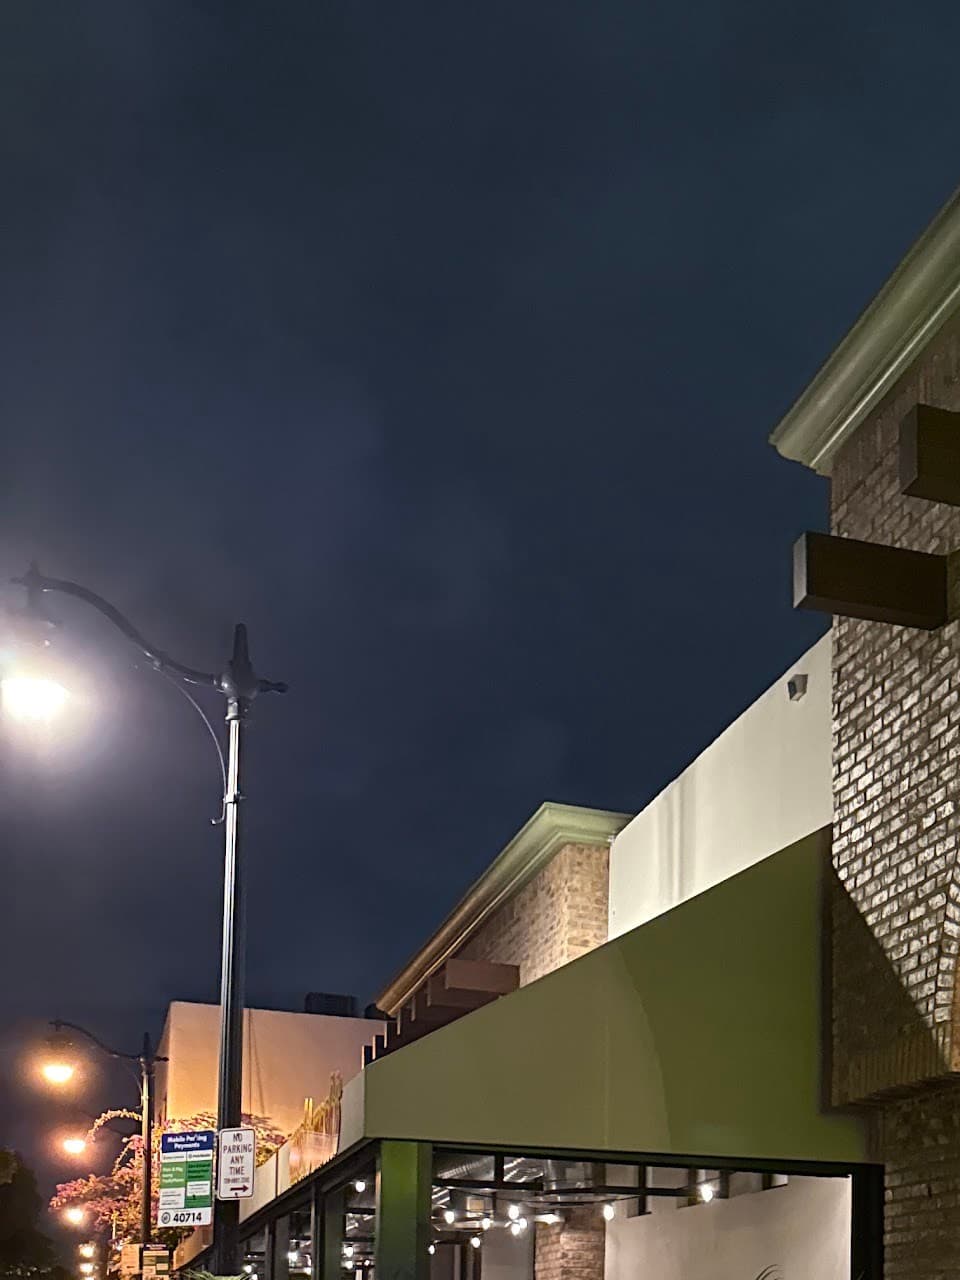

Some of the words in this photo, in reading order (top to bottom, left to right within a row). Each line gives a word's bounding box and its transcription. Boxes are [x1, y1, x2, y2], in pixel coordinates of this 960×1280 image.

[233, 1133, 243, 1142] NO
[223, 1143, 253, 1154] PARKING
[230, 1155, 245, 1165] ANY
[229, 1166, 245, 1176] TIME
[173, 1212, 202, 1223] 40714
